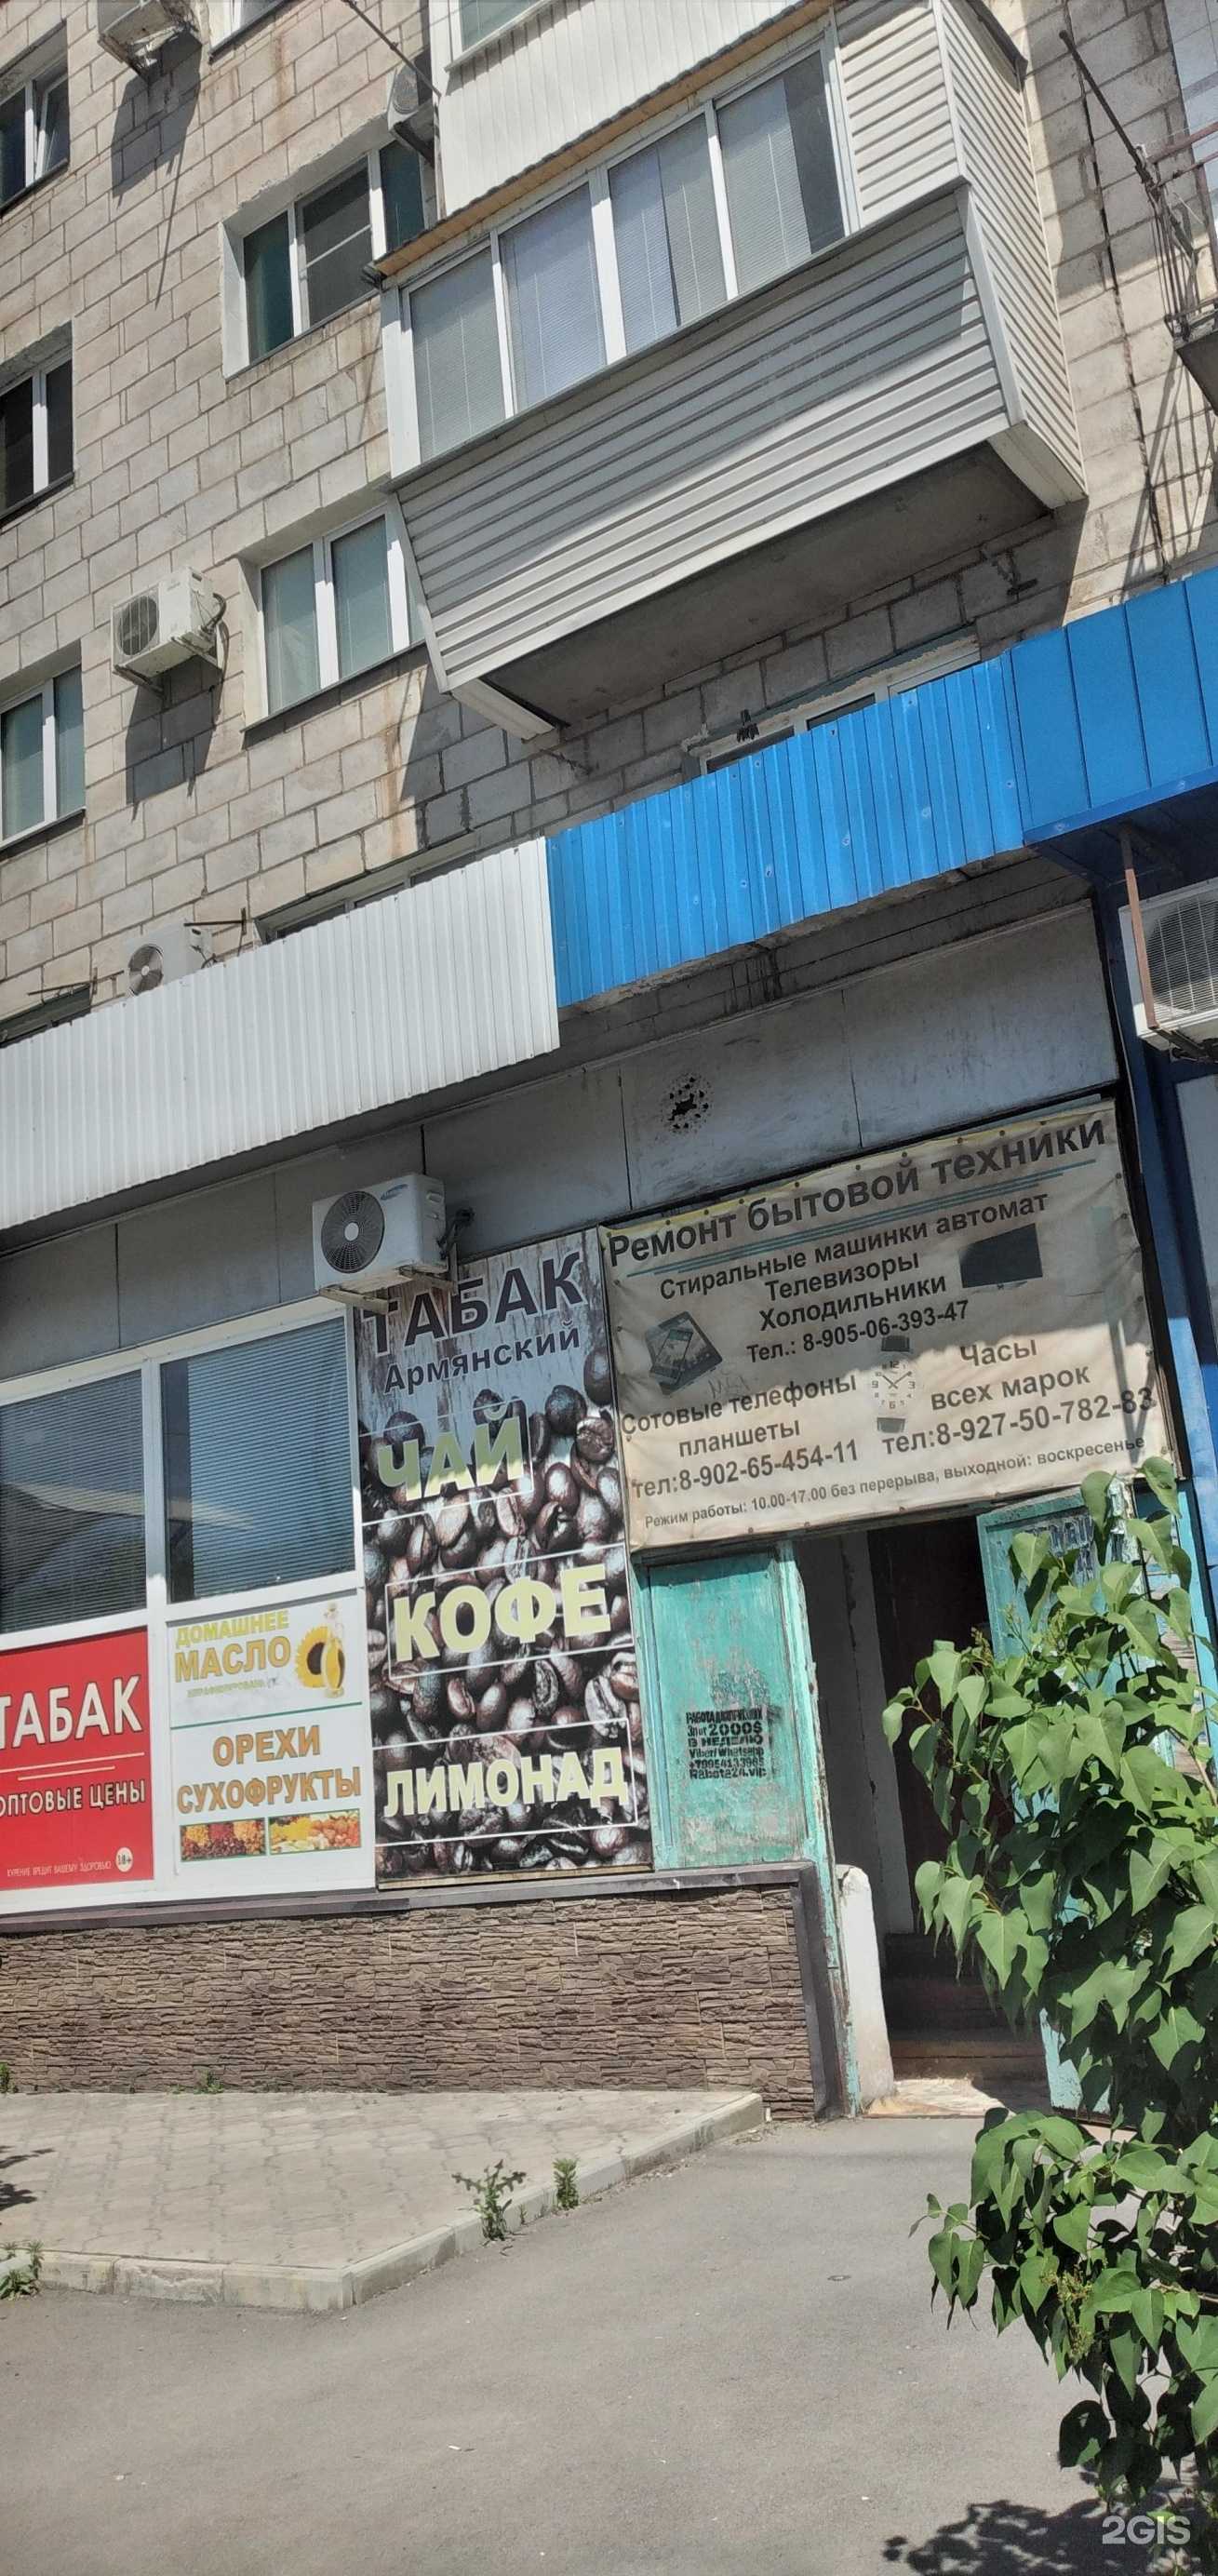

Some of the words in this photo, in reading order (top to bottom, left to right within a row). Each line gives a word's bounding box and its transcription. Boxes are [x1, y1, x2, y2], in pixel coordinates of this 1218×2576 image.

[609, 1212, 736, 1267] Ремонт
[748, 1155, 919, 1233] бытовой
[931, 1120, 1106, 1186] техники
[660, 1248, 808, 1300] Стиральные
[814, 1222, 929, 1266] машинки
[936, 1192, 1049, 1235] автомат
[364, 1250, 583, 1356] ТАБАК
[759, 1275, 947, 1333] Холодильники
[765, 1251, 920, 1302] Телевизоры
[384, 1317, 580, 1395] Армянский
[747, 1341, 796, 1365] Тел.:
[803, 1301, 970, 1352] 8-905-06-393-47
[960, 1339, 1037, 1367] Часы
[621, 1399, 723, 1435] Сотовые
[728, 1375, 857, 1415] телефоны
[930, 1383, 991, 1412] всех
[1002, 1365, 1091, 1401] марок
[376, 1402, 525, 1502] ЧАЙ
[678, 1419, 801, 1458] планшеты
[883, 1388, 1153, 1456] тел:8-927-50-782-83
[632, 1441, 859, 1499] тел:8-902-65-454-11
[645, 1509, 688, 1529] Режим
[692, 1499, 748, 1524] работы:
[751, 1485, 827, 1511] 10.00-17.00
[831, 1482, 856, 1496] без
[860, 1470, 940, 1496] перерыва,
[944, 1454, 1032, 1483] выходной:
[1037, 1435, 1145, 1466] воскресенье
[176, 1610, 289, 1648] ДОМАШНЕЕ
[391, 1563, 611, 1663] КОФЕ
[174, 1636, 291, 1683] МАСЛО
[0, 1676, 143, 1750] ТАБАК
[213, 1725, 321, 1766] ОРЕХИ
[89, 1778, 146, 1808] ЦЕНЫ
[177, 1767, 362, 1814] СУХОФРУКТЫ
[384, 1747, 630, 1818] ЛИМОНАД
